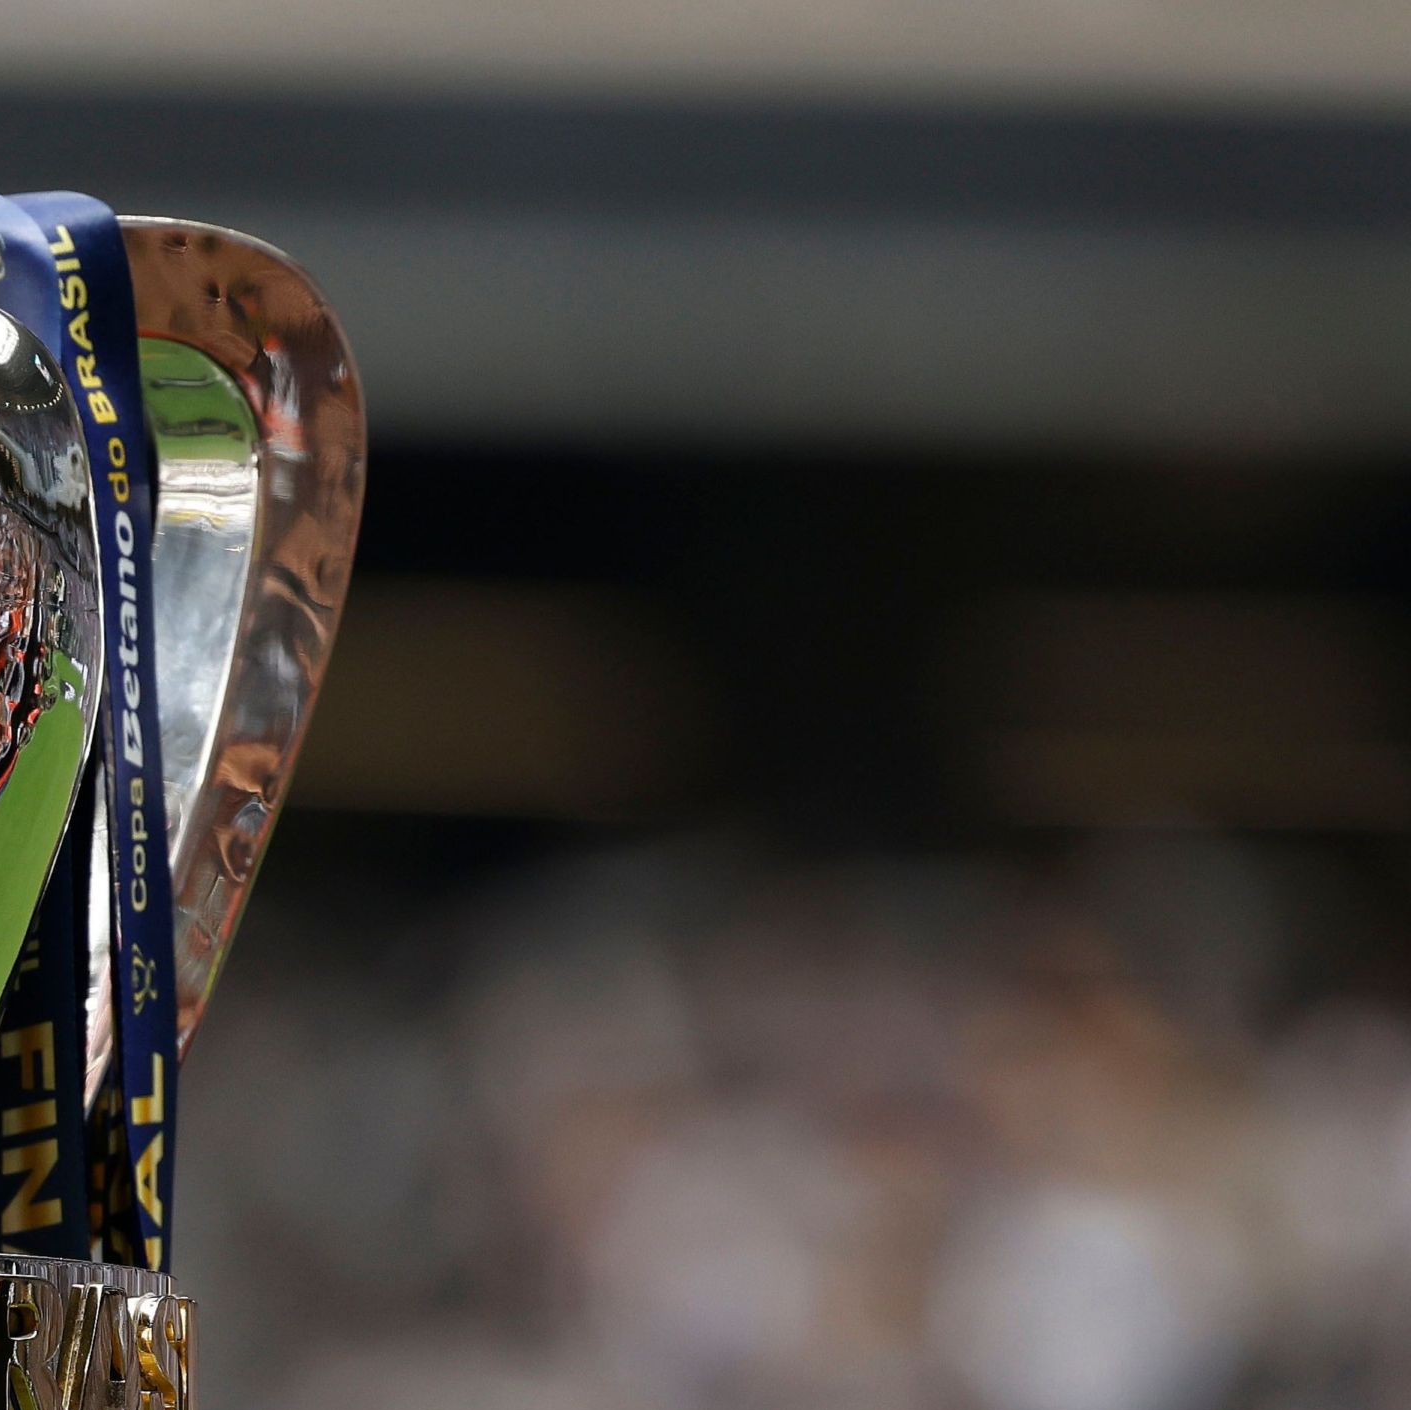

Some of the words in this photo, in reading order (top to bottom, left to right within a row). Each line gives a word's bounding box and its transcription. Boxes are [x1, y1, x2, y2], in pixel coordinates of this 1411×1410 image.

[50, 223, 119, 425] BRASIL
[107, 437, 131, 503] do
[115, 510, 145, 768] Betano
[129, 777, 149, 912] Copa
[0, 1020, 64, 1253] FIN
